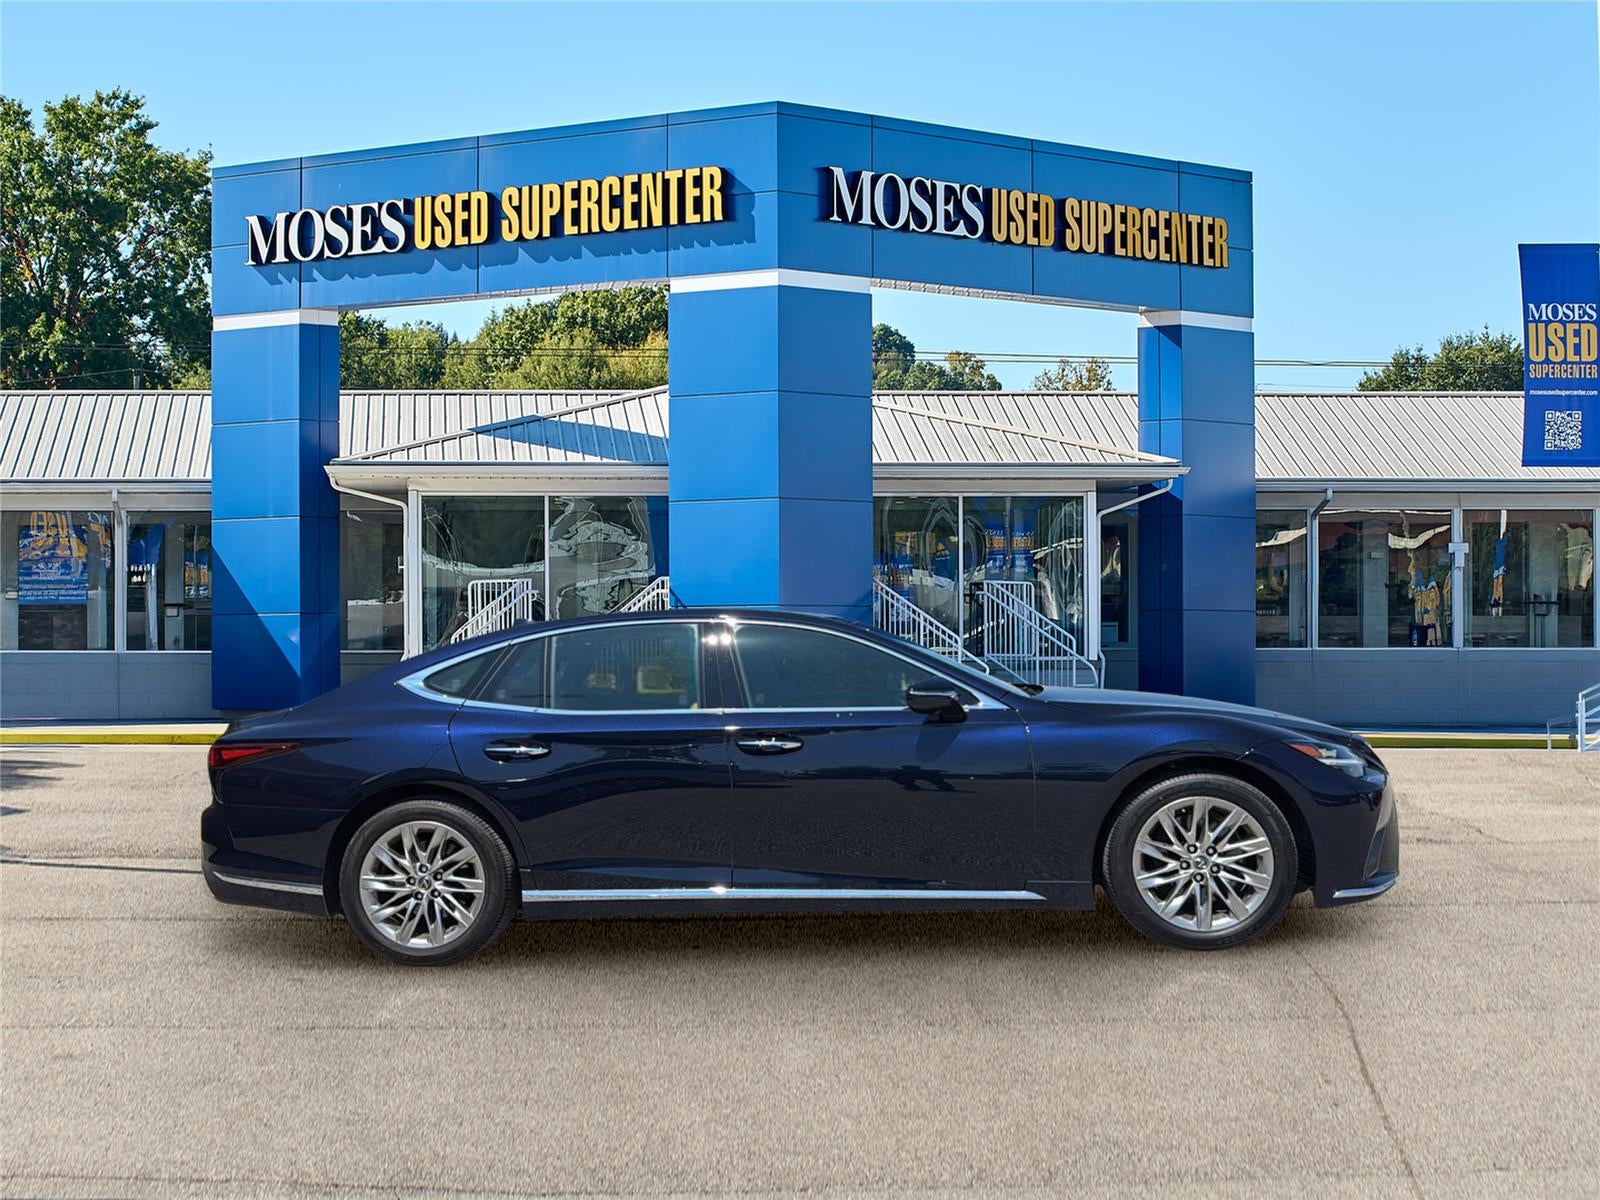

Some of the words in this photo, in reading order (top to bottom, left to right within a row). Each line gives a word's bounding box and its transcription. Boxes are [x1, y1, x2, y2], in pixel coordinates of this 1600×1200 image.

[245, 199, 406, 266] MOSES
[413, 190, 489, 250] USED
[501, 166, 724, 242] SUPERCENTER
[828, 166, 984, 240] MOSES
[991, 188, 1055, 247] USED
[1065, 197, 1229, 268] SUPERCENTER
[1528, 303, 1597, 321] MOSES
[1528, 323, 1598, 362] USED
[1529, 364, 1598, 379] SUPERCENTER
